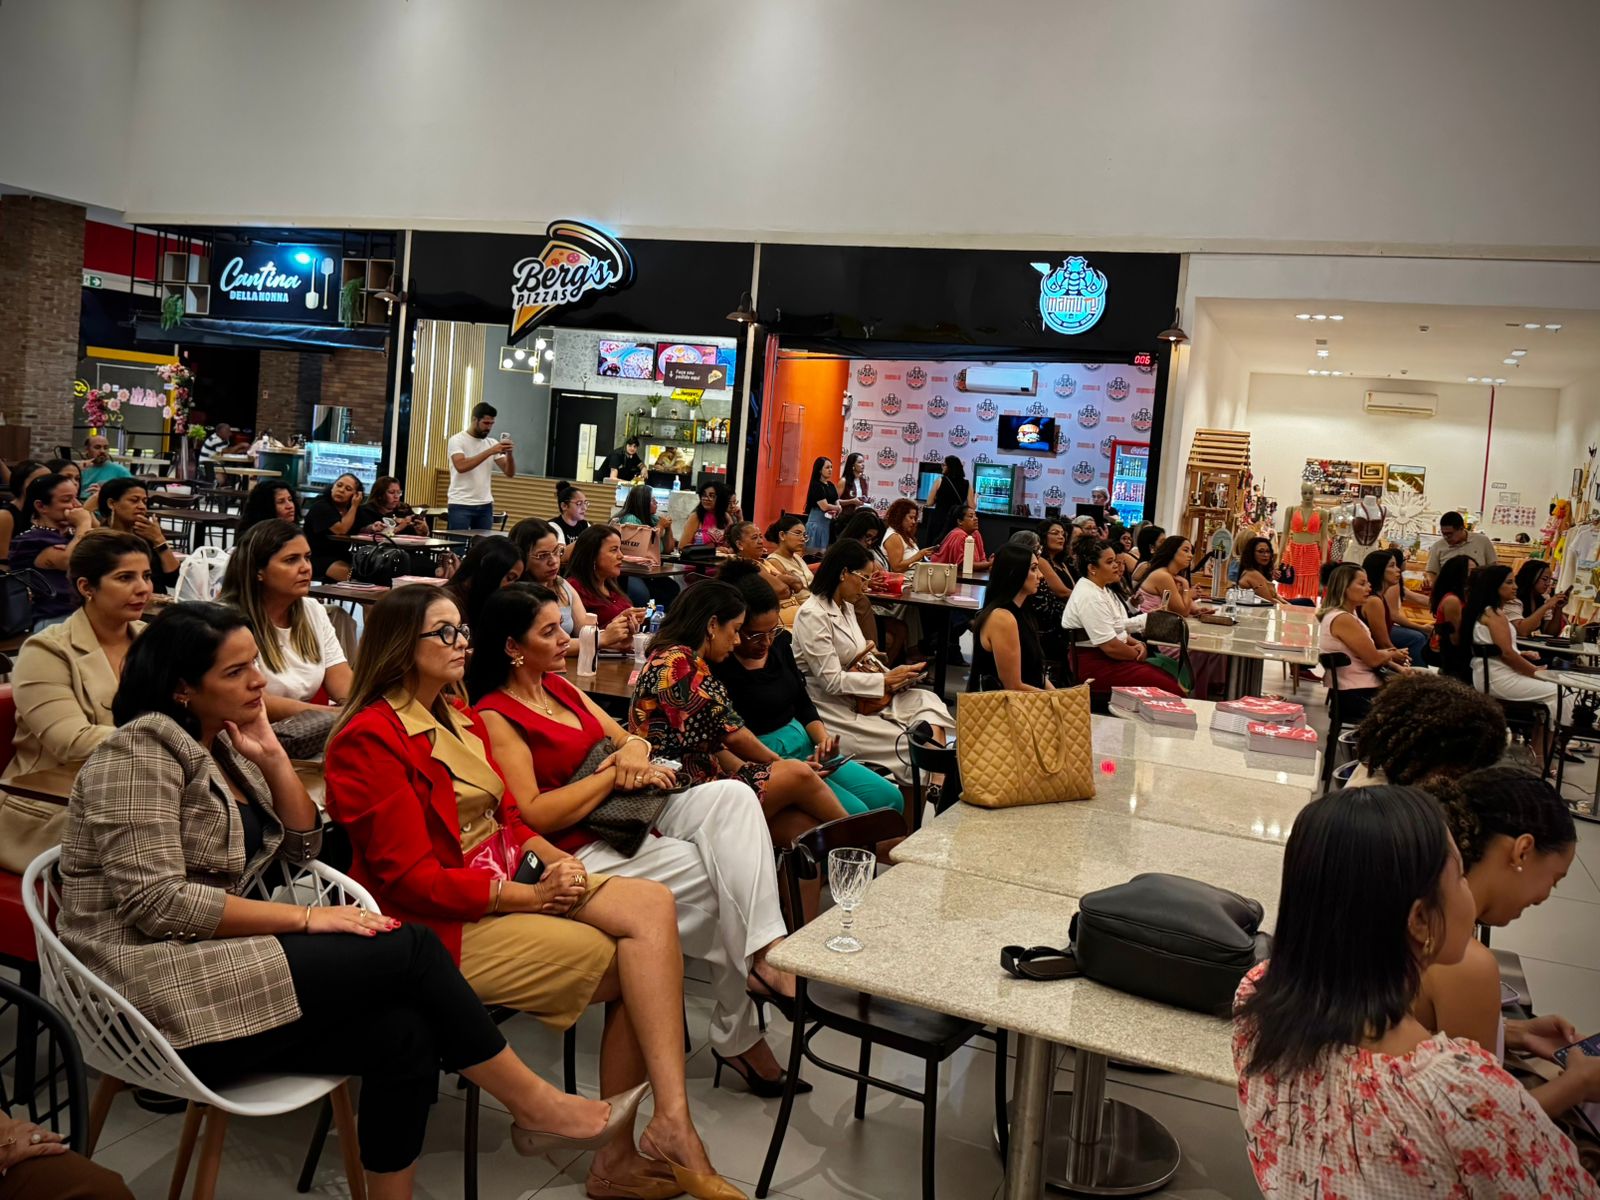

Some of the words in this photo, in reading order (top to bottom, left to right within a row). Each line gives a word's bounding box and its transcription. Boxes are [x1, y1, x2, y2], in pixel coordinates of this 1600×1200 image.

[220, 256, 302, 292] Cantina
[515, 258, 612, 298] Berg's
[516, 288, 568, 306] PIZZAS
[1134, 355, 1151, 365] 006
